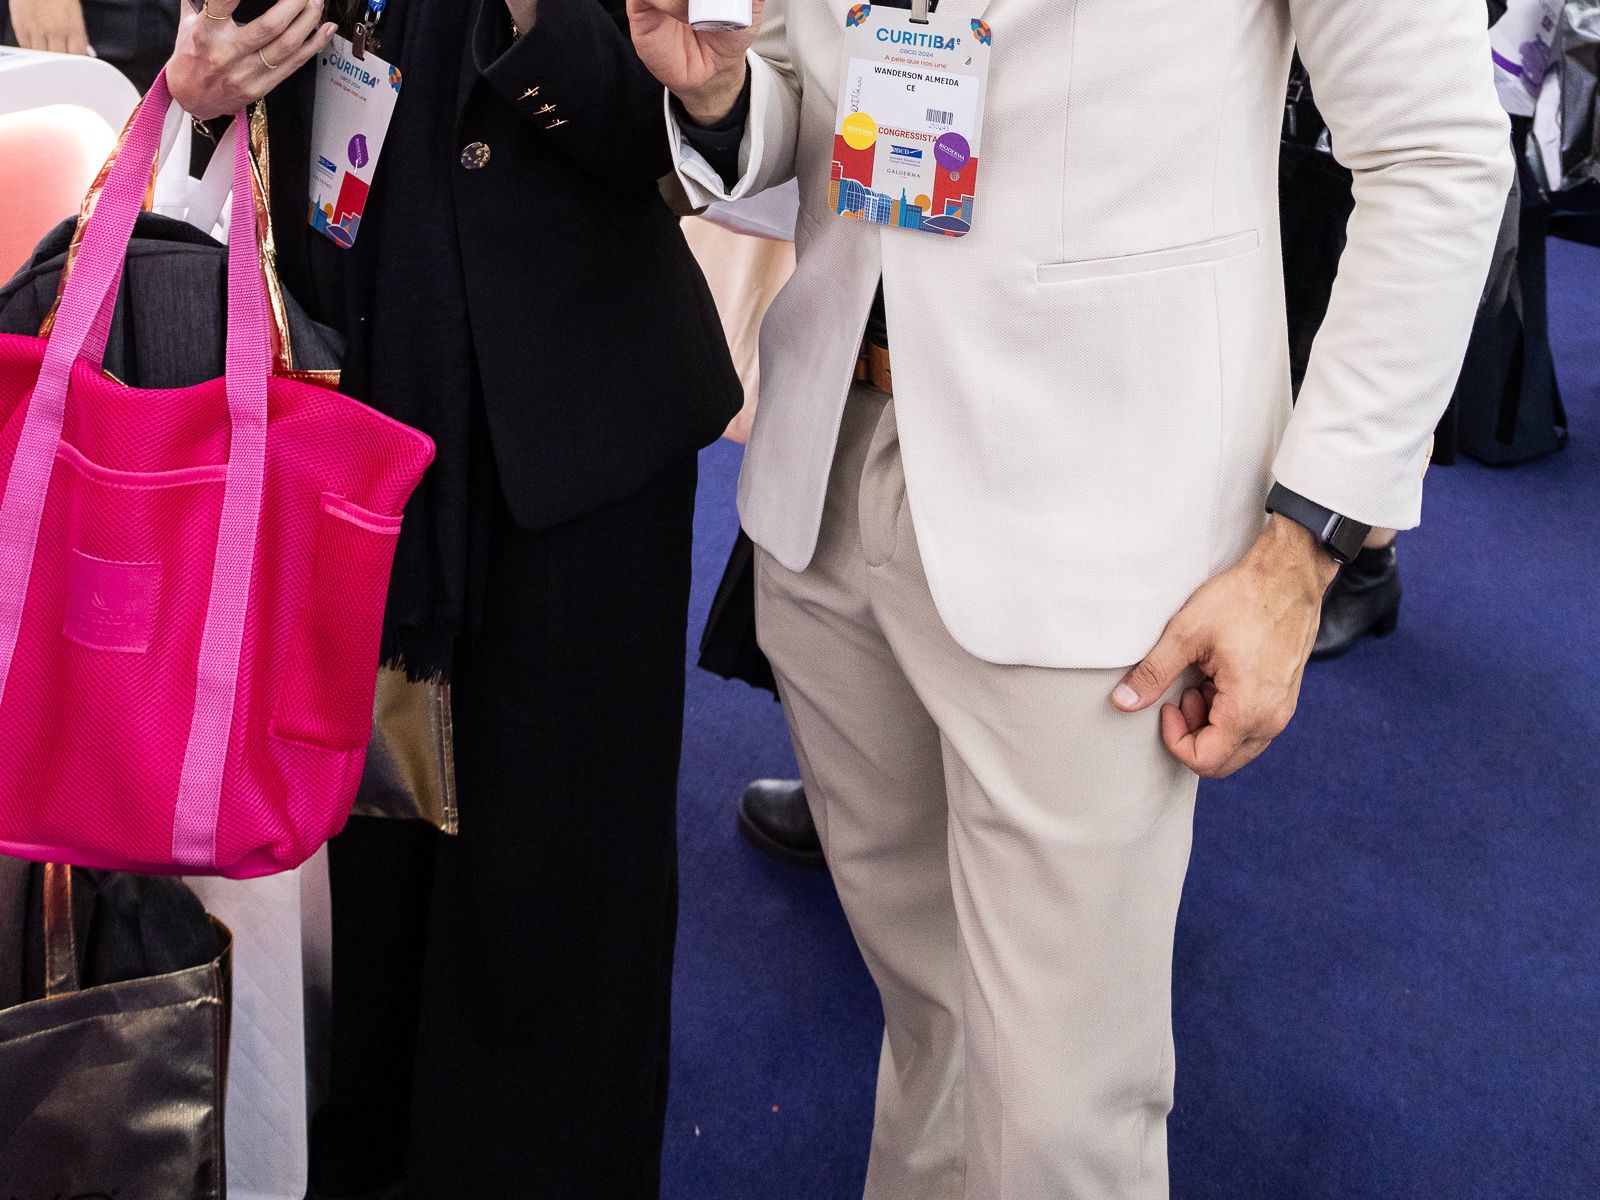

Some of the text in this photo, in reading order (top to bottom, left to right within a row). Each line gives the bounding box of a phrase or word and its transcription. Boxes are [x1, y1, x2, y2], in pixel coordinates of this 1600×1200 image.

[874, 66, 960, 87] WANDERSON ALMEIDA
[906, 84, 916, 92] CE
[878, 126, 938, 143] CONGRESSISTA
[886, 168, 921, 178] GALDERMA
